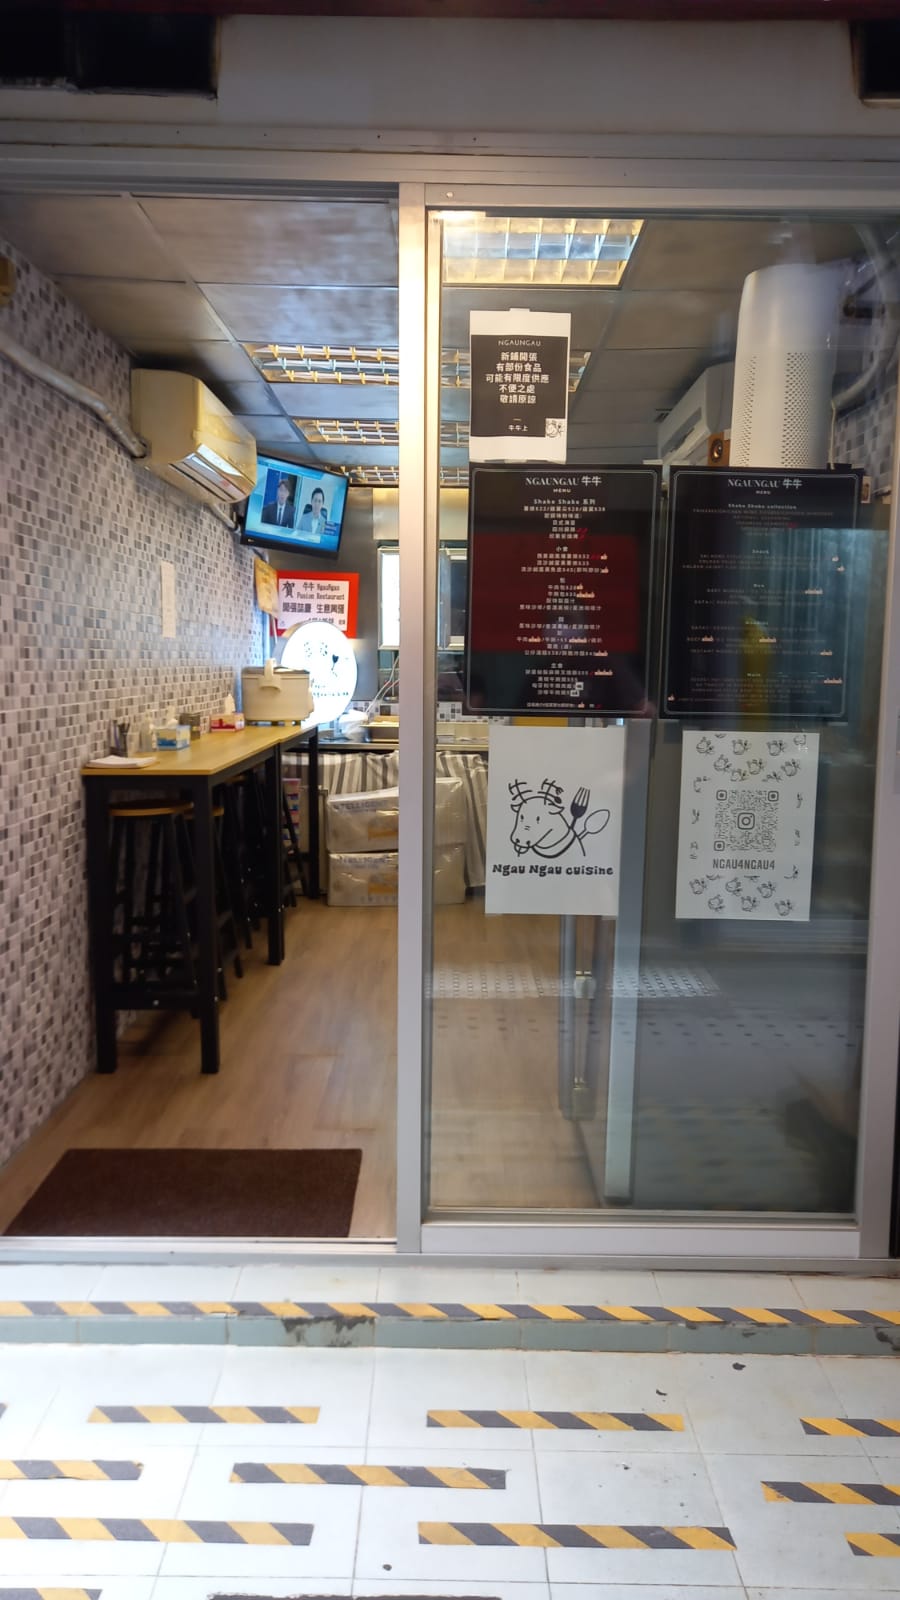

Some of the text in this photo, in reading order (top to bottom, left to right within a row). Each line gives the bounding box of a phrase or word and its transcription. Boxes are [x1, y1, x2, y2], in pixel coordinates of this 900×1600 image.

[498, 339, 541, 347] NGAUNGAU
[496, 363, 542, 373] 有部份食品
[485, 373, 549, 384] 可能有限度供應
[498, 384, 536, 394] 不便之處
[499, 394, 537, 404] 敬請原諒
[525, 476, 602, 487] NGAUNGAU 牛牛
[727, 478, 803, 489] NGAUNGAU 牛牛
[281, 580, 295, 598] 賀
[316, 592, 345, 600] Restaurant
[712, 858, 775, 870] NGAU4NGAU4
[492, 864, 614, 877] Ngau Ngau cuisine
